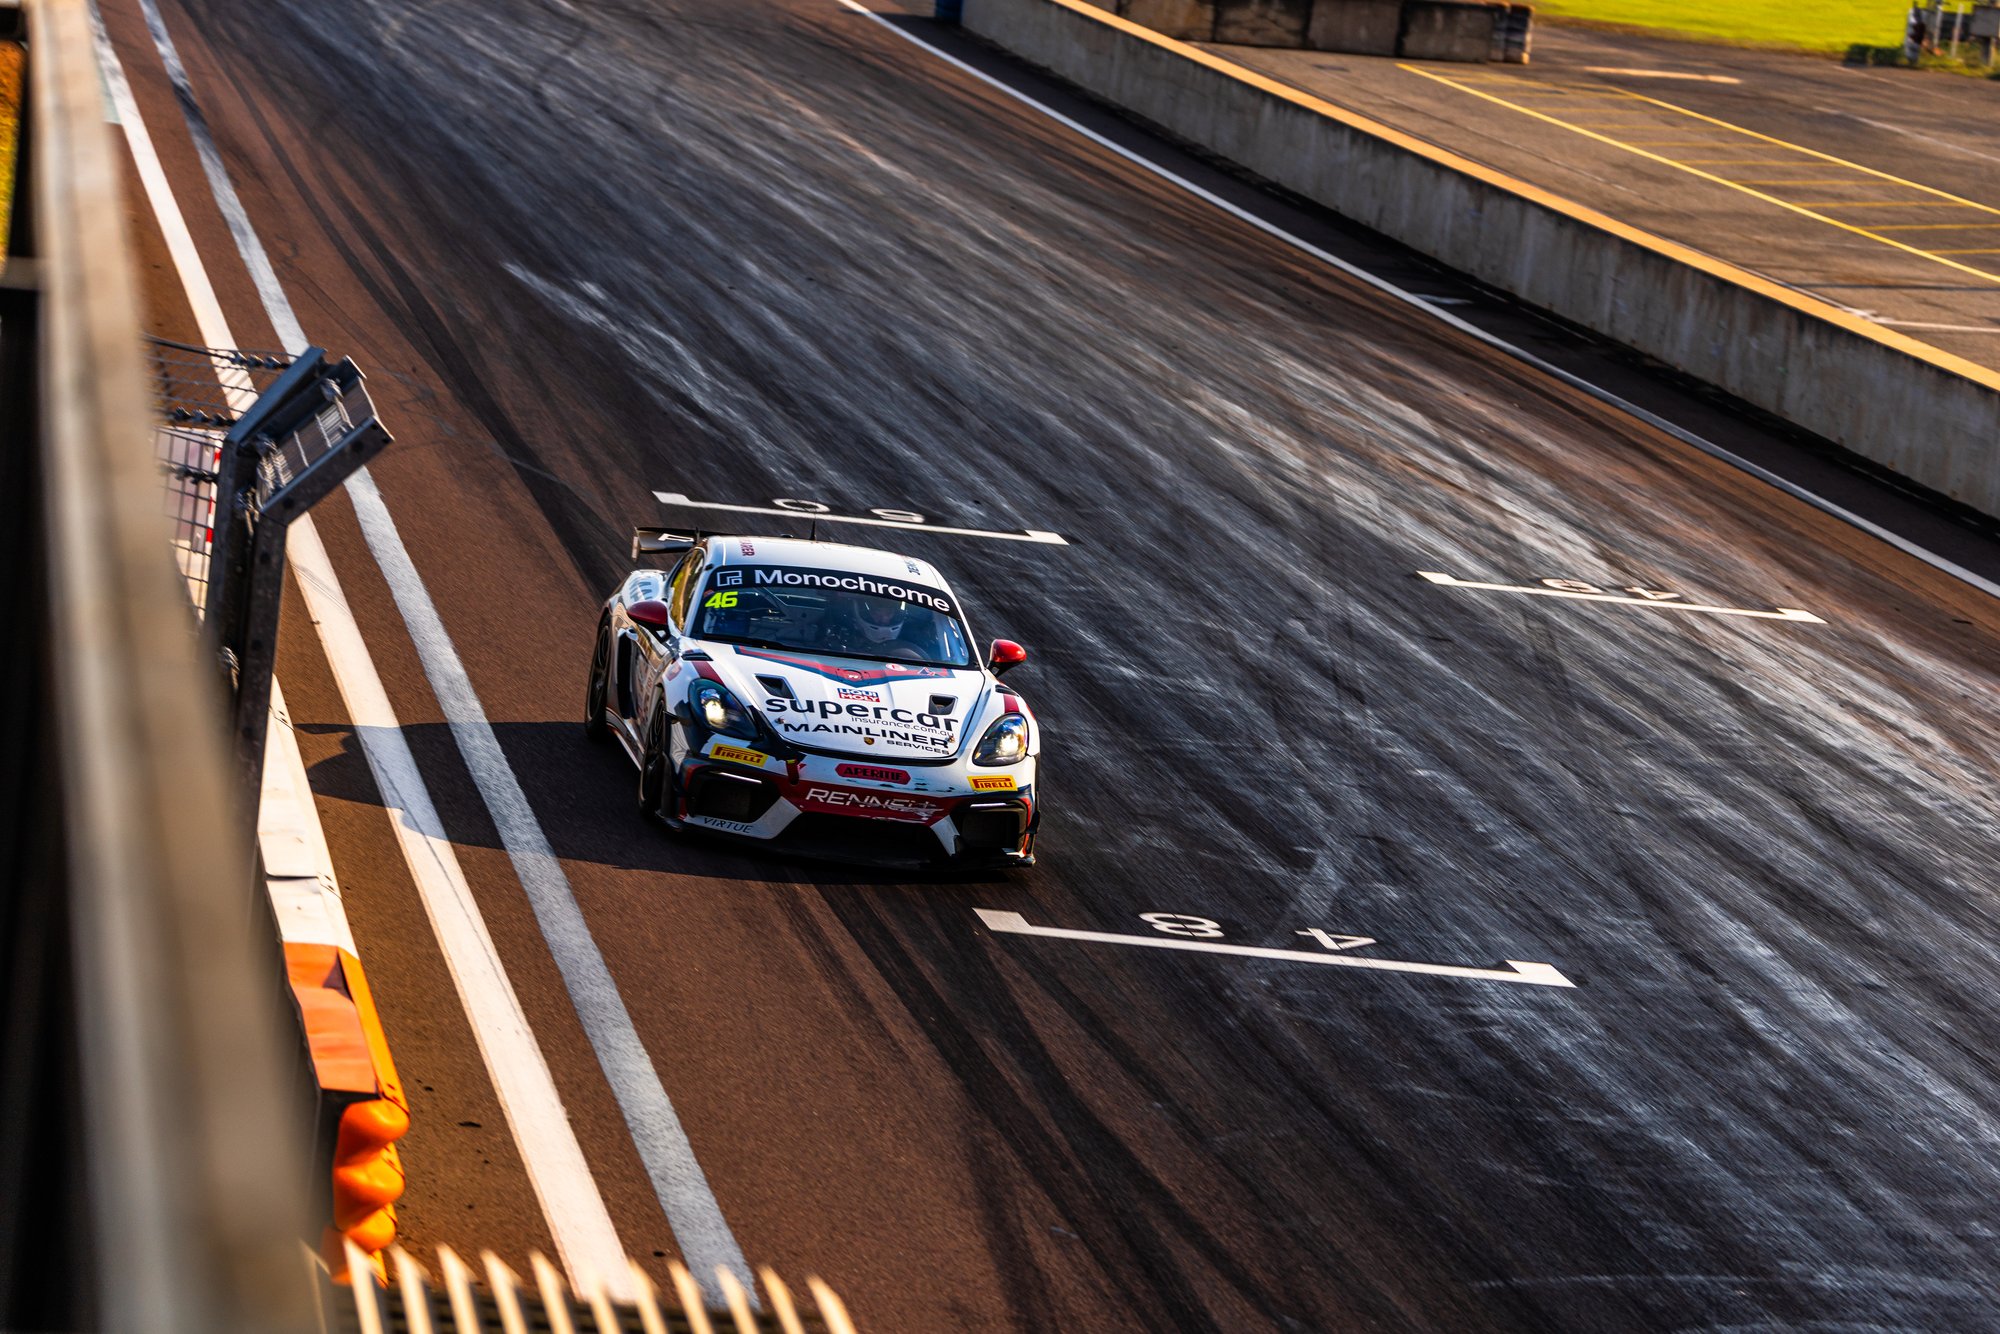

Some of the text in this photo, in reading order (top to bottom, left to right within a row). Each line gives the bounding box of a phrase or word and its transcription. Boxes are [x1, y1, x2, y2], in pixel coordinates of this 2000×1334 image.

[754, 569, 950, 612] Monochrome
[705, 591, 739, 609] 46
[841, 693, 879, 702] MOLY
[765, 698, 959, 732] supercar
[784, 723, 950, 749] MAINLINER
[851, 717, 955, 738] insurance.com.au
[714, 746, 763, 764] PIRELLI
[886, 740, 950, 755] SERVICES
[843, 766, 904, 782] APERITIF
[972, 777, 1013, 788] PIRELLI
[703, 817, 754, 834] VIRTUE
[1138, 911, 1377, 950] 48
